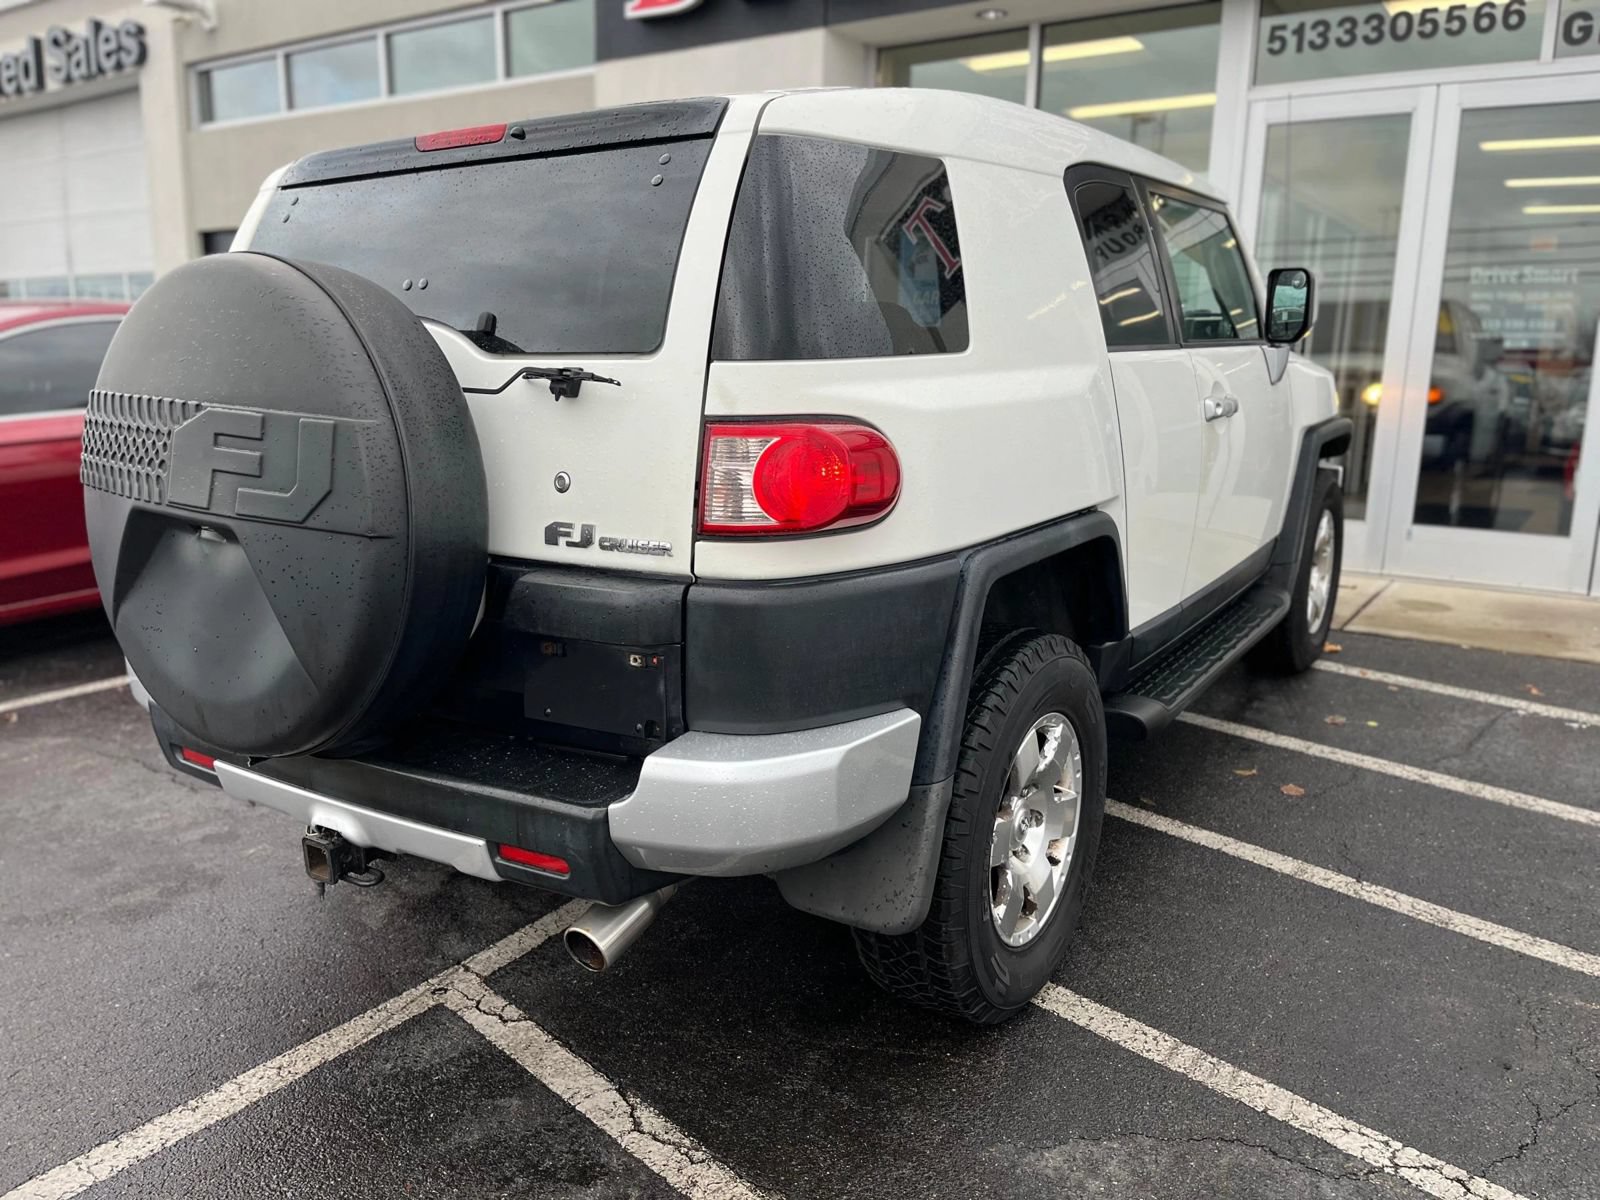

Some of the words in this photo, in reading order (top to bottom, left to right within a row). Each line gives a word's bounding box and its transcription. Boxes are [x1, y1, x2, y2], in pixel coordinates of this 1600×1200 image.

[47, 17, 147, 84] Sales
[1266, 0, 1527, 57] 5133305566
[1522, 265, 1579, 284] Smart
[167, 407, 336, 524] FJ
[544, 521, 597, 549] FJ
[598, 536, 674, 558] CRUISER
